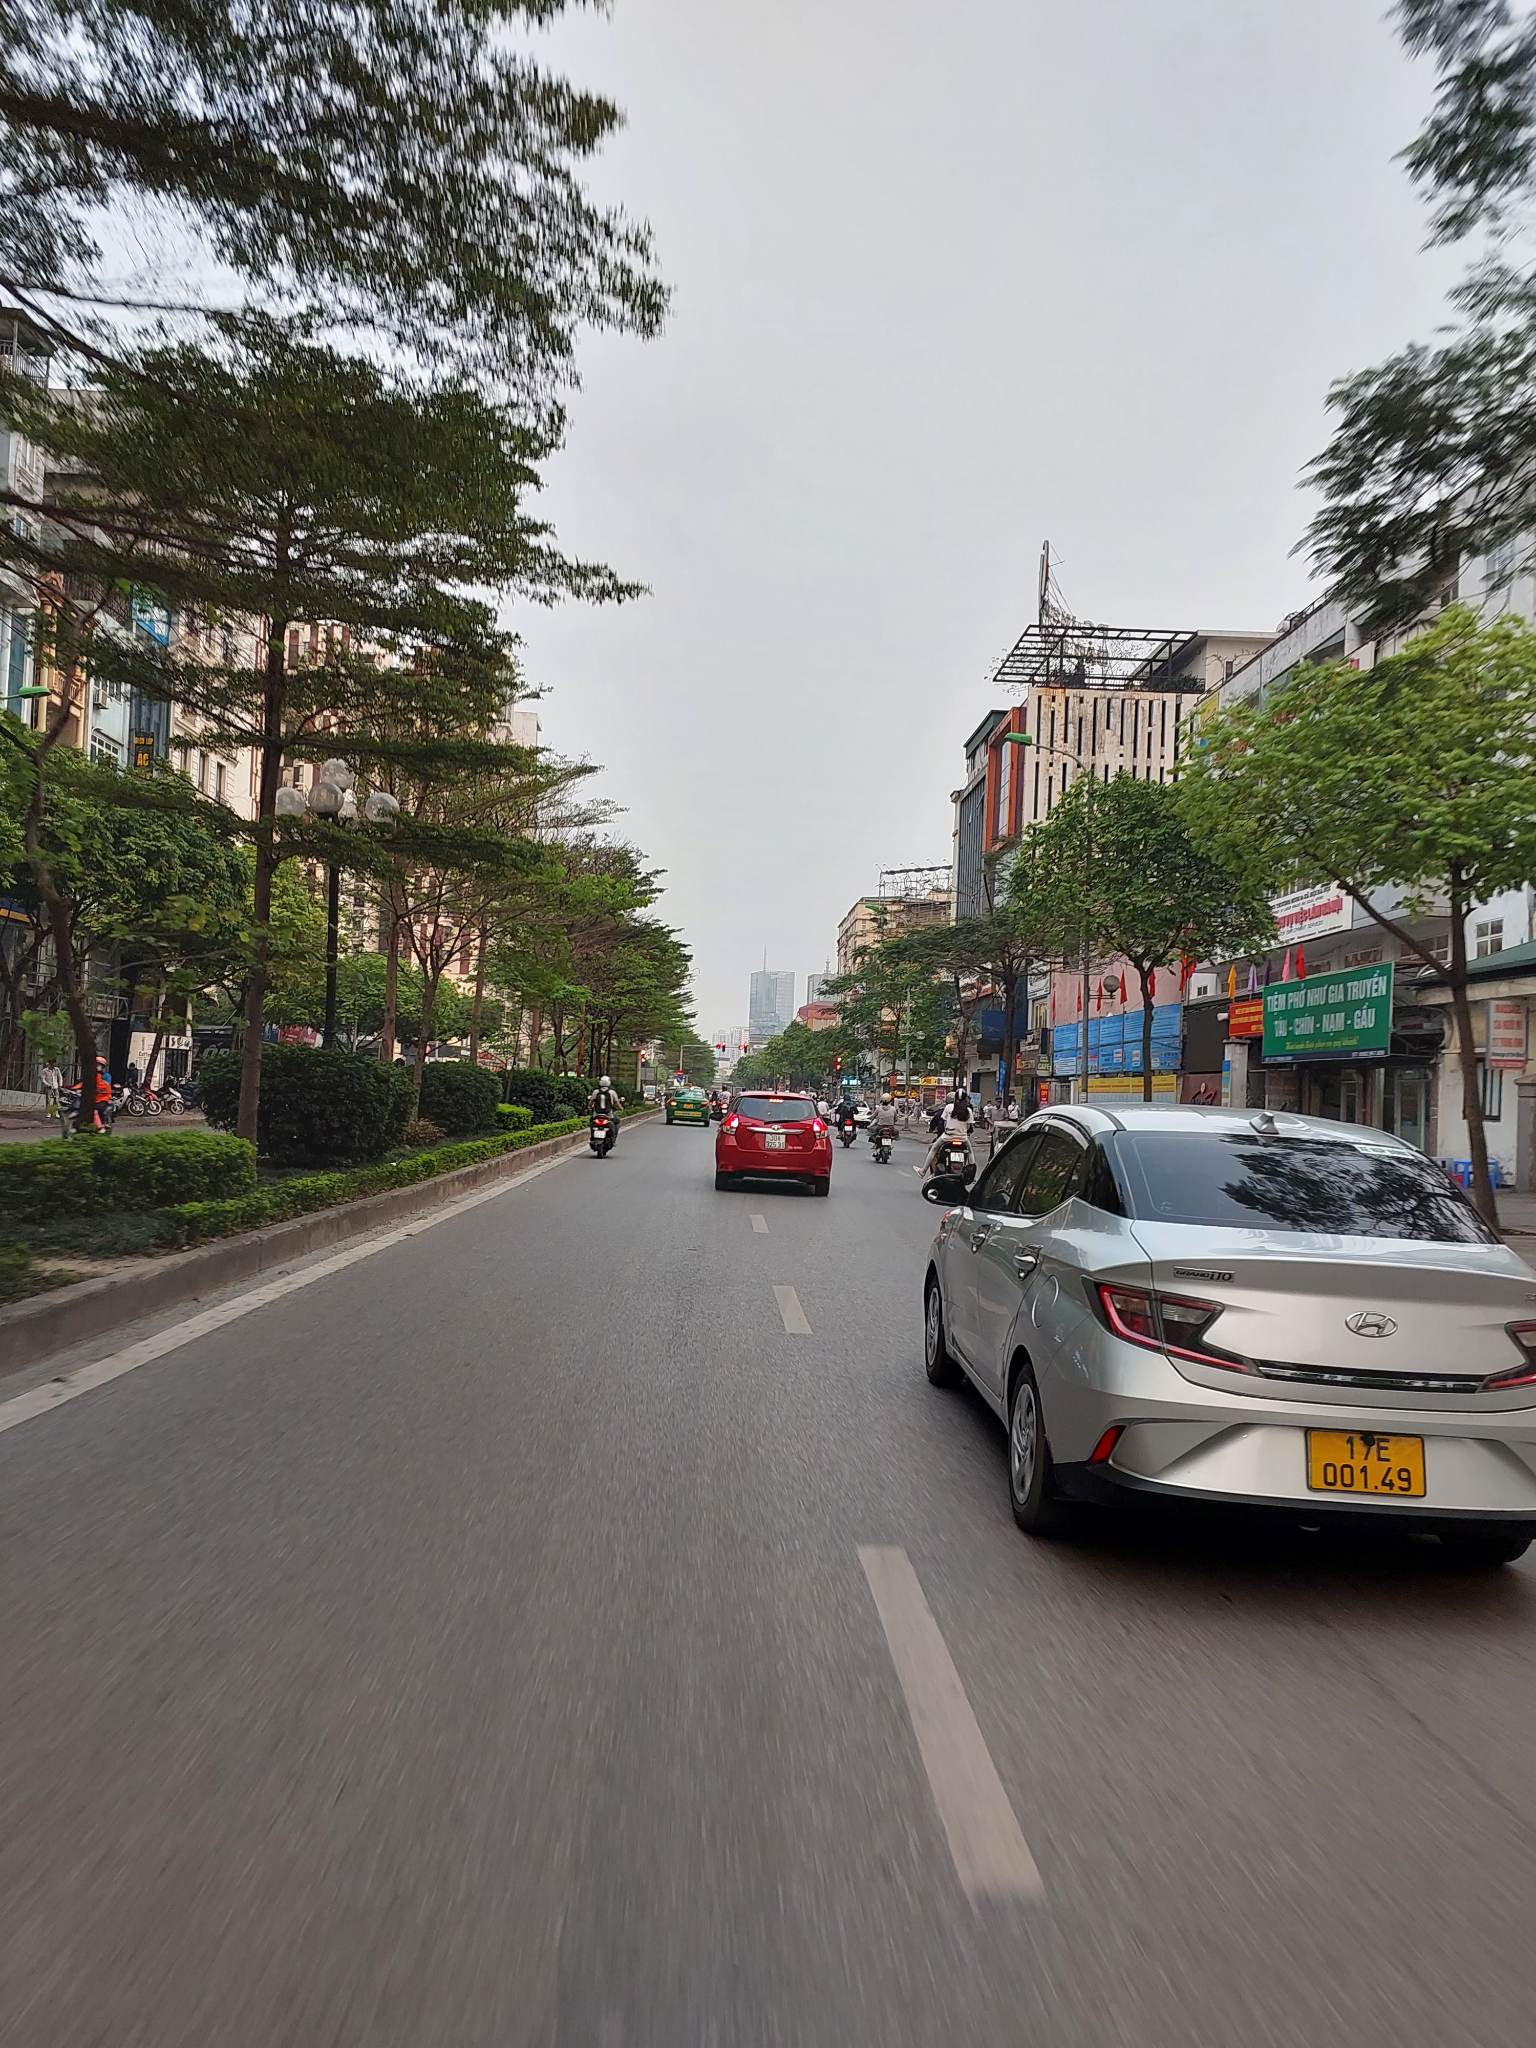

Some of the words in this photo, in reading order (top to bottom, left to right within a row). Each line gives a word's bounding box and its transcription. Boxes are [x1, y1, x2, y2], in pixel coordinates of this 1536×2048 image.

[1328, 983, 1345, 1003] GIA
[1346, 1436, 1391, 1462] 17E
[1323, 1463, 1411, 1491] 001.49
